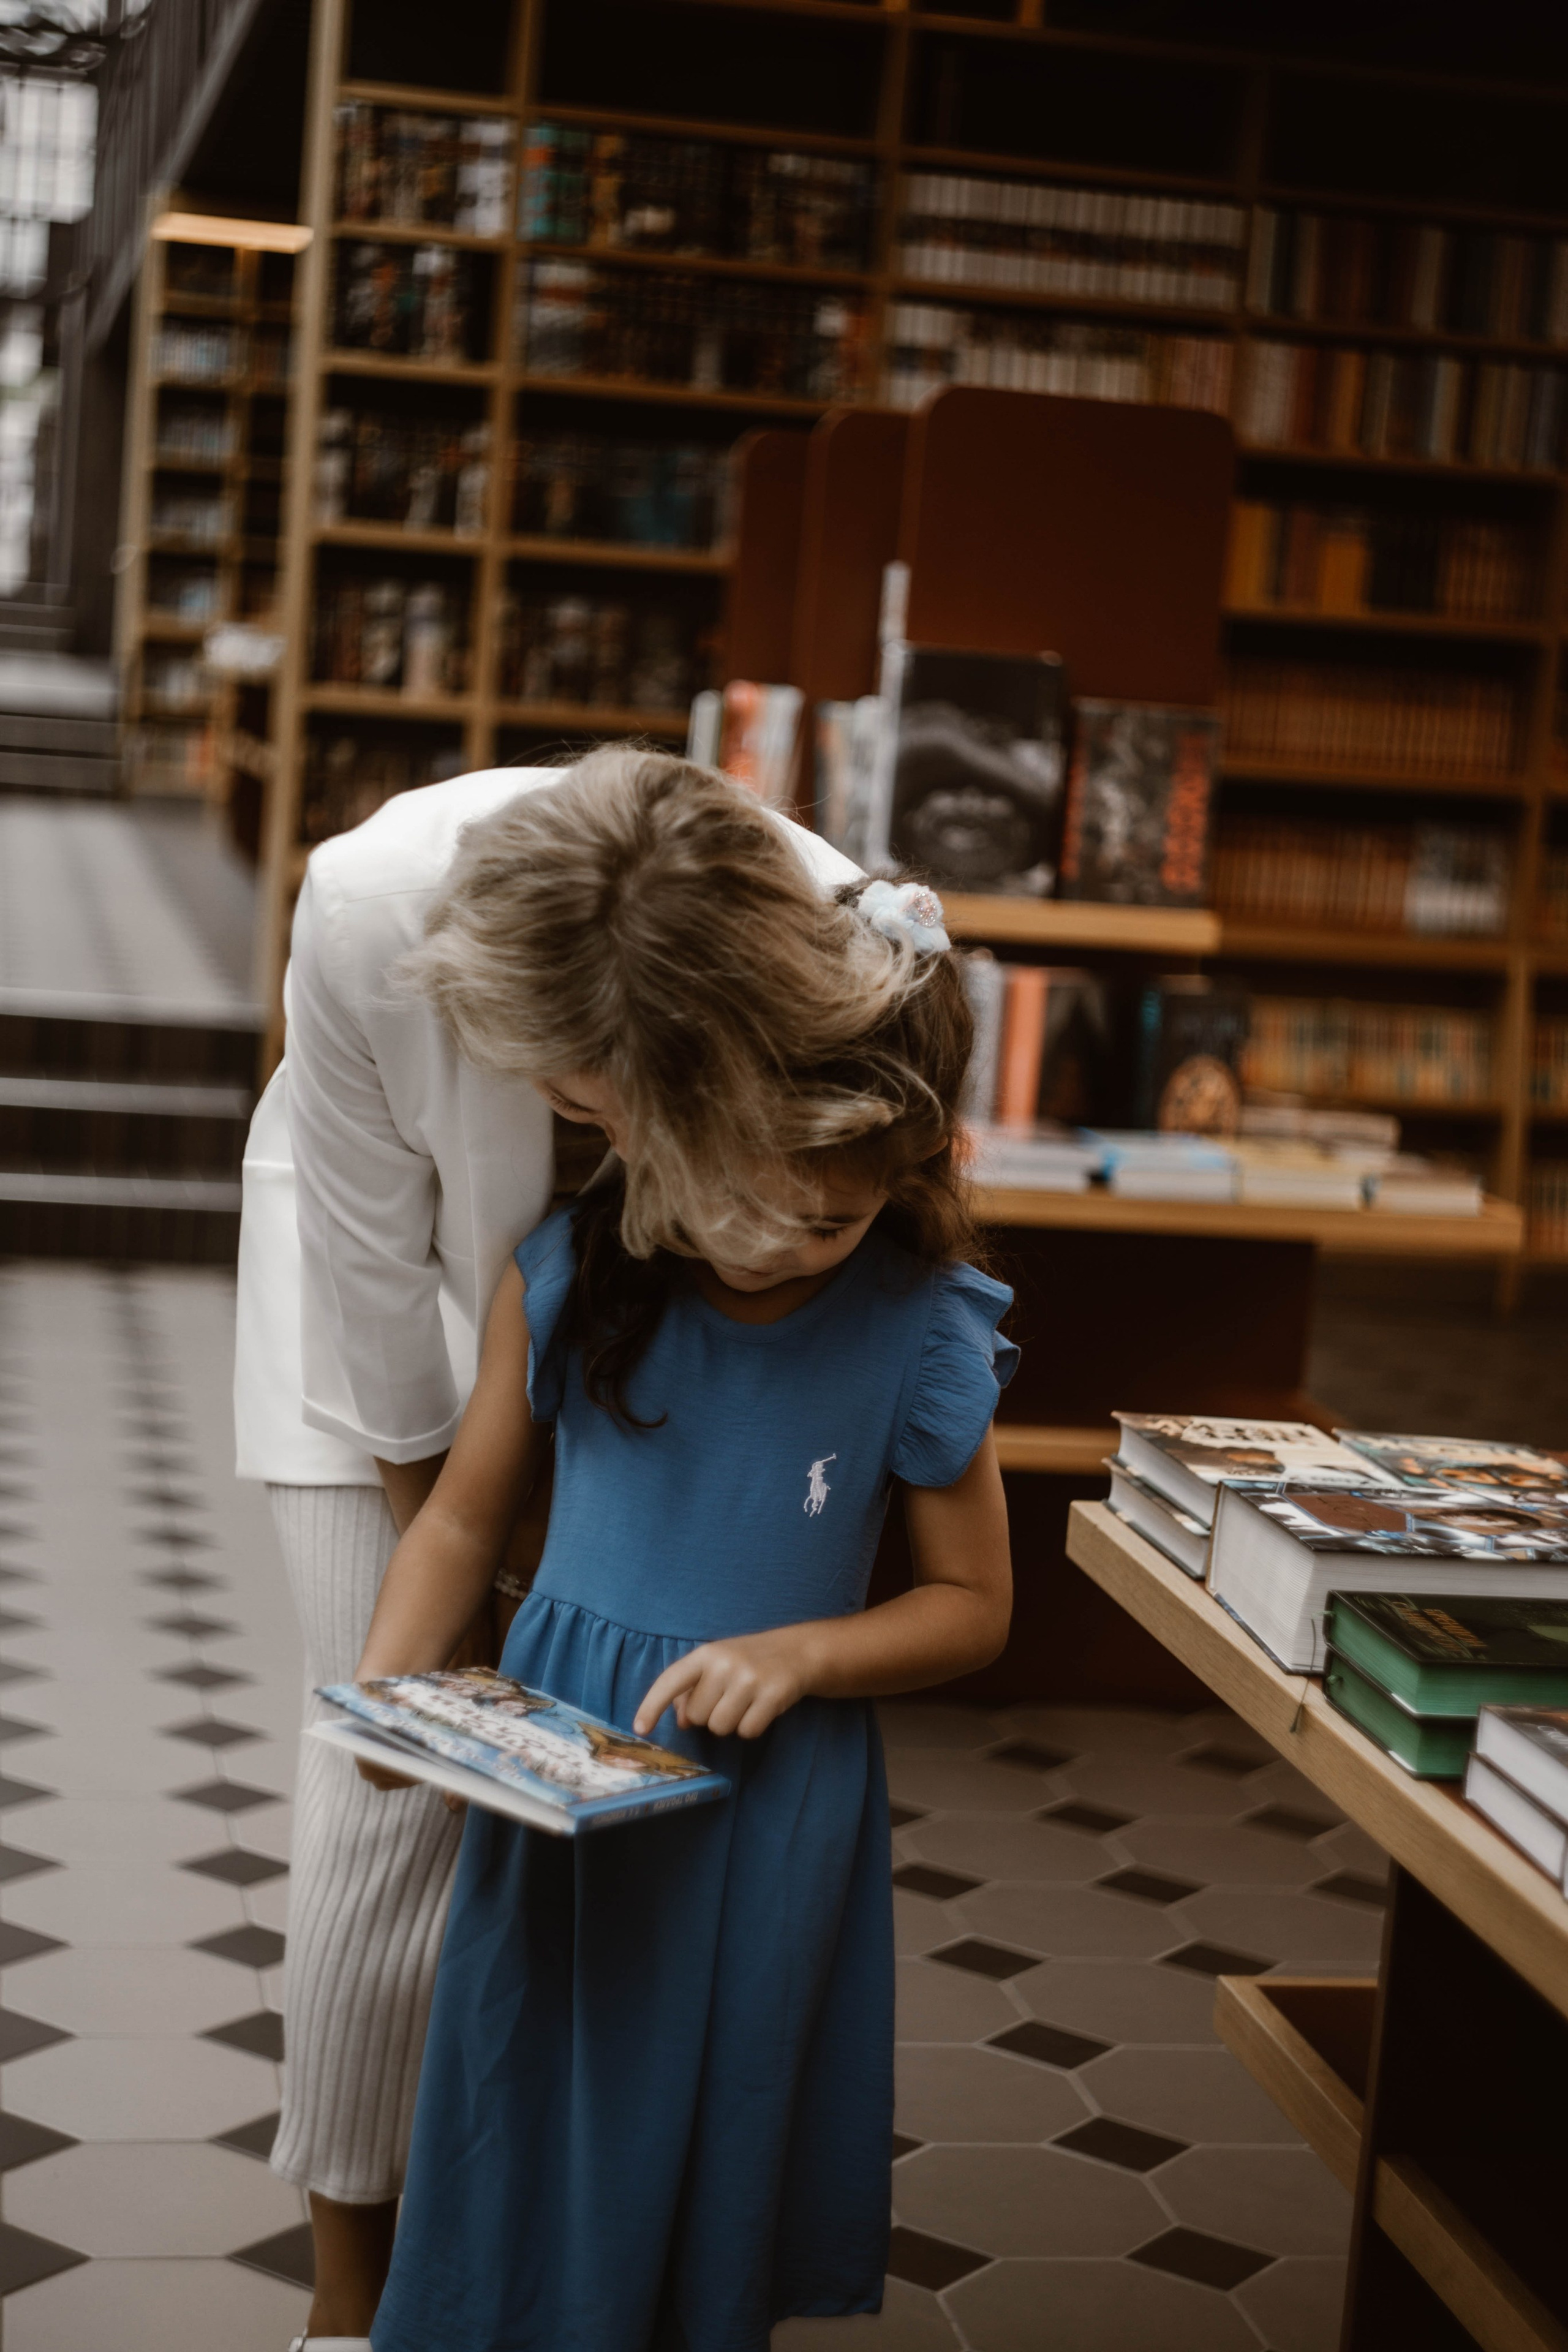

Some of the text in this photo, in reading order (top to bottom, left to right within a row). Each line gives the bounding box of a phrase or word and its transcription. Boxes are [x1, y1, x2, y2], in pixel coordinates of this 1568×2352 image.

[1422, 1608, 1487, 1646] БРЕНДОН
[429, 1693, 583, 1768] ТРОЛЛЕЙ
[461, 1717, 531, 1751] ПРО
[684, 1791, 699, 1804] ПРО
